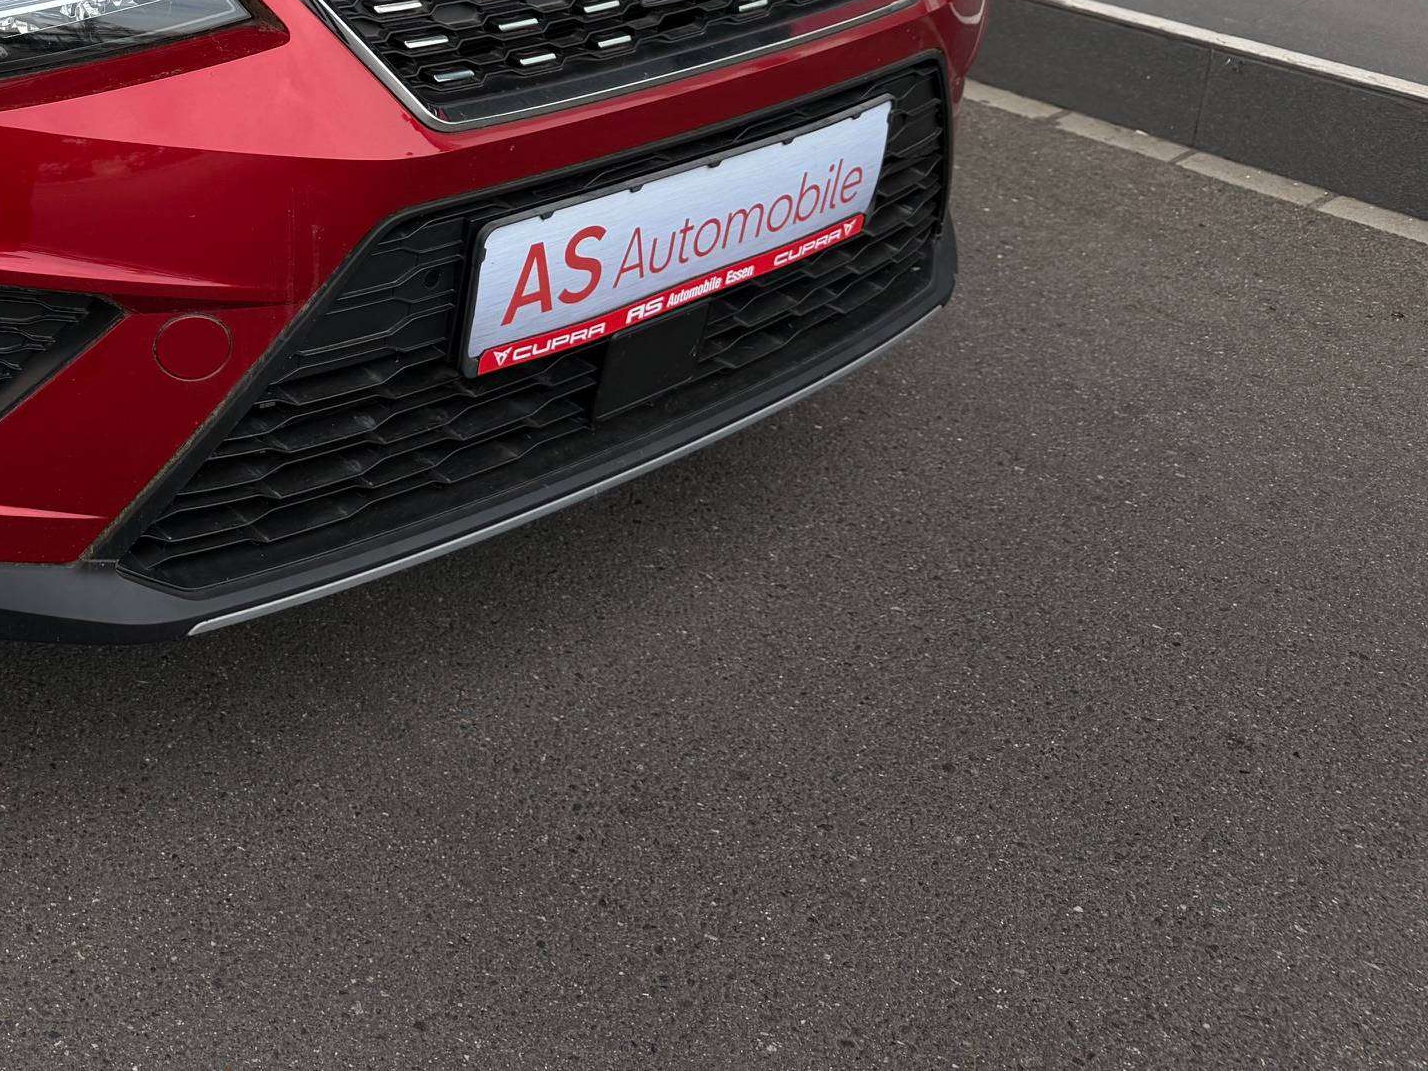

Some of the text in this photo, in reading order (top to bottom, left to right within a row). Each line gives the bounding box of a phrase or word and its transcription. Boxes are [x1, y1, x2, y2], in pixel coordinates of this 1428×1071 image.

[500, 158, 863, 326] AS Automobile
[513, 228, 842, 361] CUPRA AS Automobile Essen CUPRA
